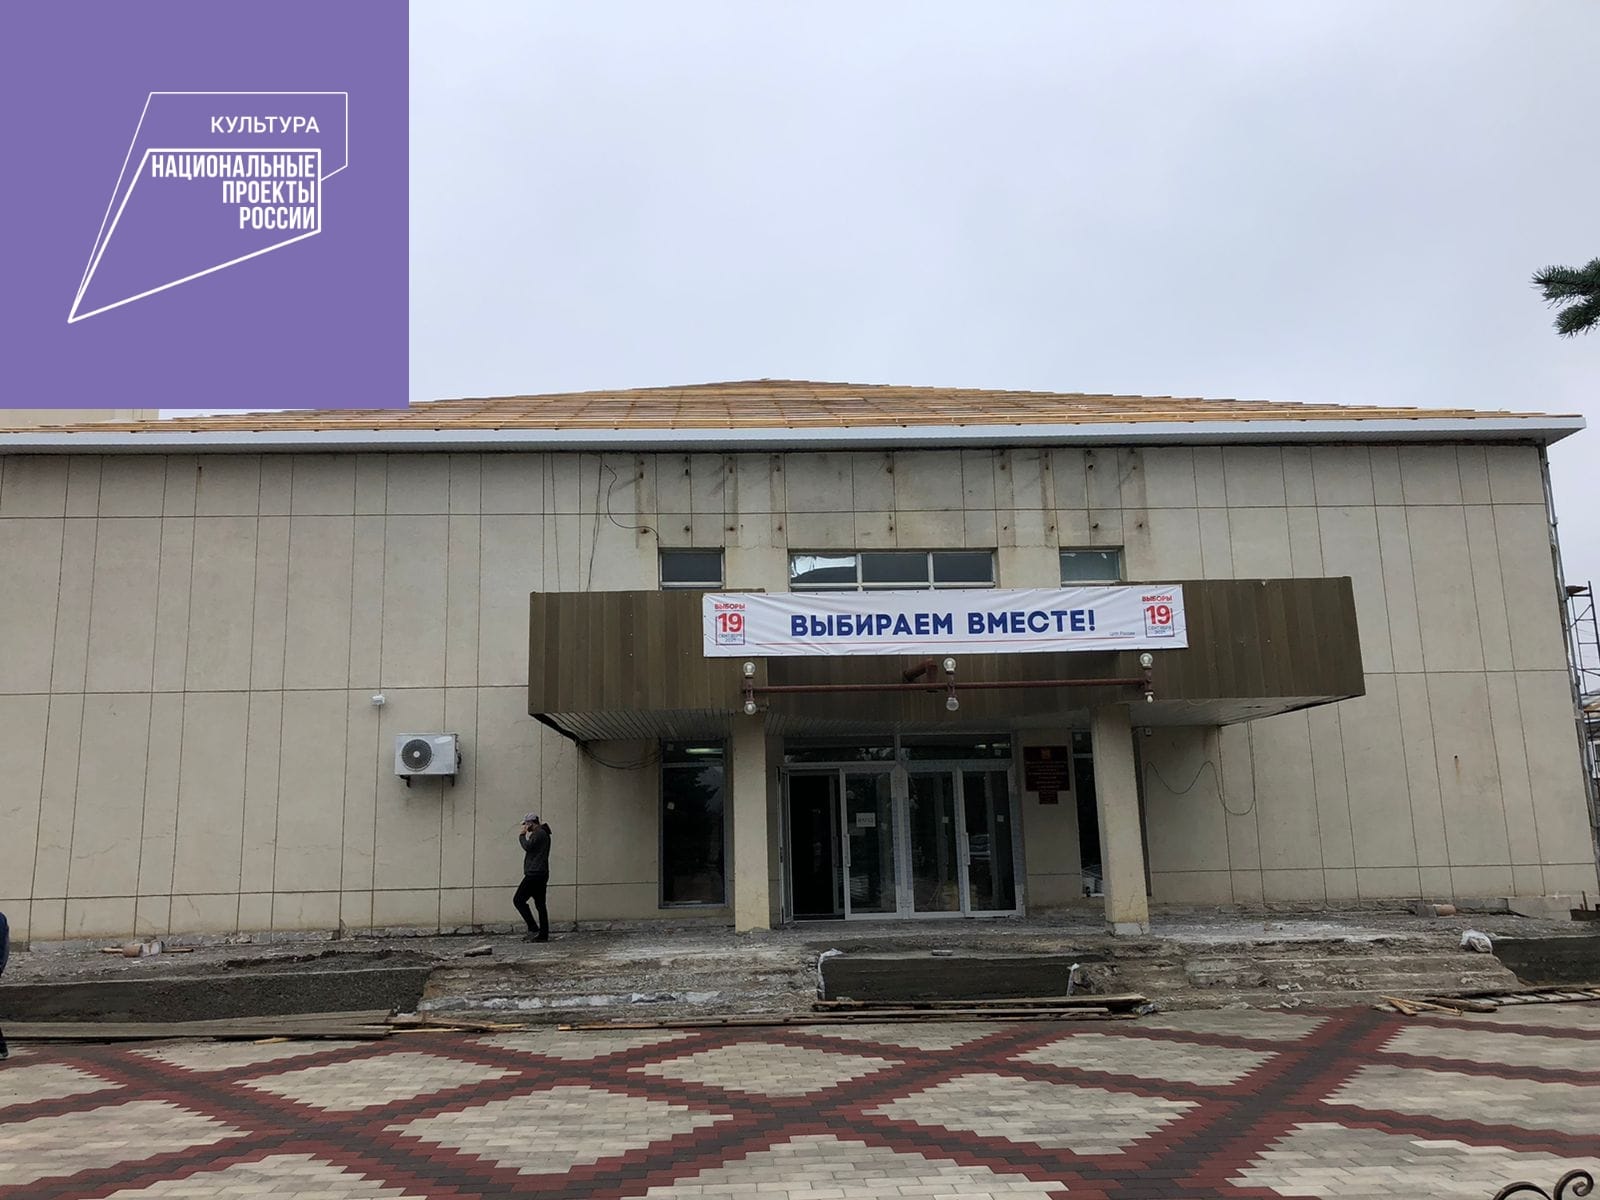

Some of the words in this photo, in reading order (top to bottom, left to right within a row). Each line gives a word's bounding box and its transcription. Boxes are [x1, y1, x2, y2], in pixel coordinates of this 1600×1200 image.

[718, 613, 742, 632] 19
[790, 612, 954, 637] ВЫБИРАЕМ
[967, 609, 1096, 635] ВМЕСТЕ!
[1146, 605, 1171, 625] 19
